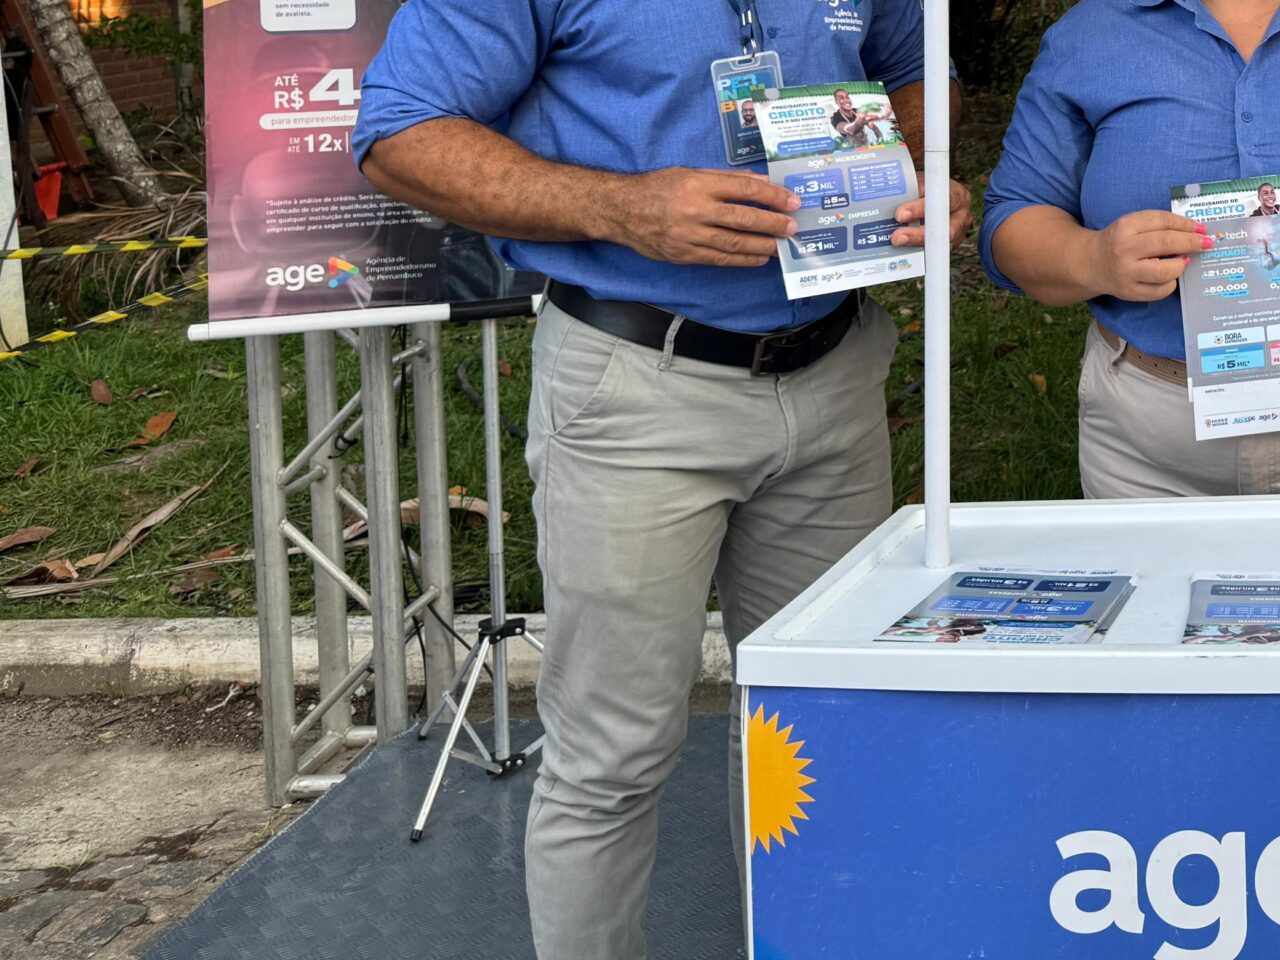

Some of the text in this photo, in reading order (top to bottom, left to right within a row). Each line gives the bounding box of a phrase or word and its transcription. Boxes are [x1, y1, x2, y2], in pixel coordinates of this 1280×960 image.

[290, 1, 330, 9] necessidade
[274, 73, 299, 87] ATÉ
[274, 68, 362, 111] R$ 4
[271, 116, 291, 127] para
[289, 137, 300, 145] EM
[304, 133, 343, 153] 12x
[287, 144, 301, 153] ATÉ
[807, 158, 825, 169] age
[806, 181, 820, 192] 3
[818, 214, 837, 225] age
[867, 234, 877, 244] 3
[1225, 229, 1248, 240] tech
[366, 255, 406, 265] Agência de
[365, 262, 437, 273] Empreendedorismo
[265, 263, 325, 291] age
[366, 272, 423, 282] de Pernambuco
[1224, 332, 1242, 340] BORA
[1217, 360, 1236, 370] R$ 5
